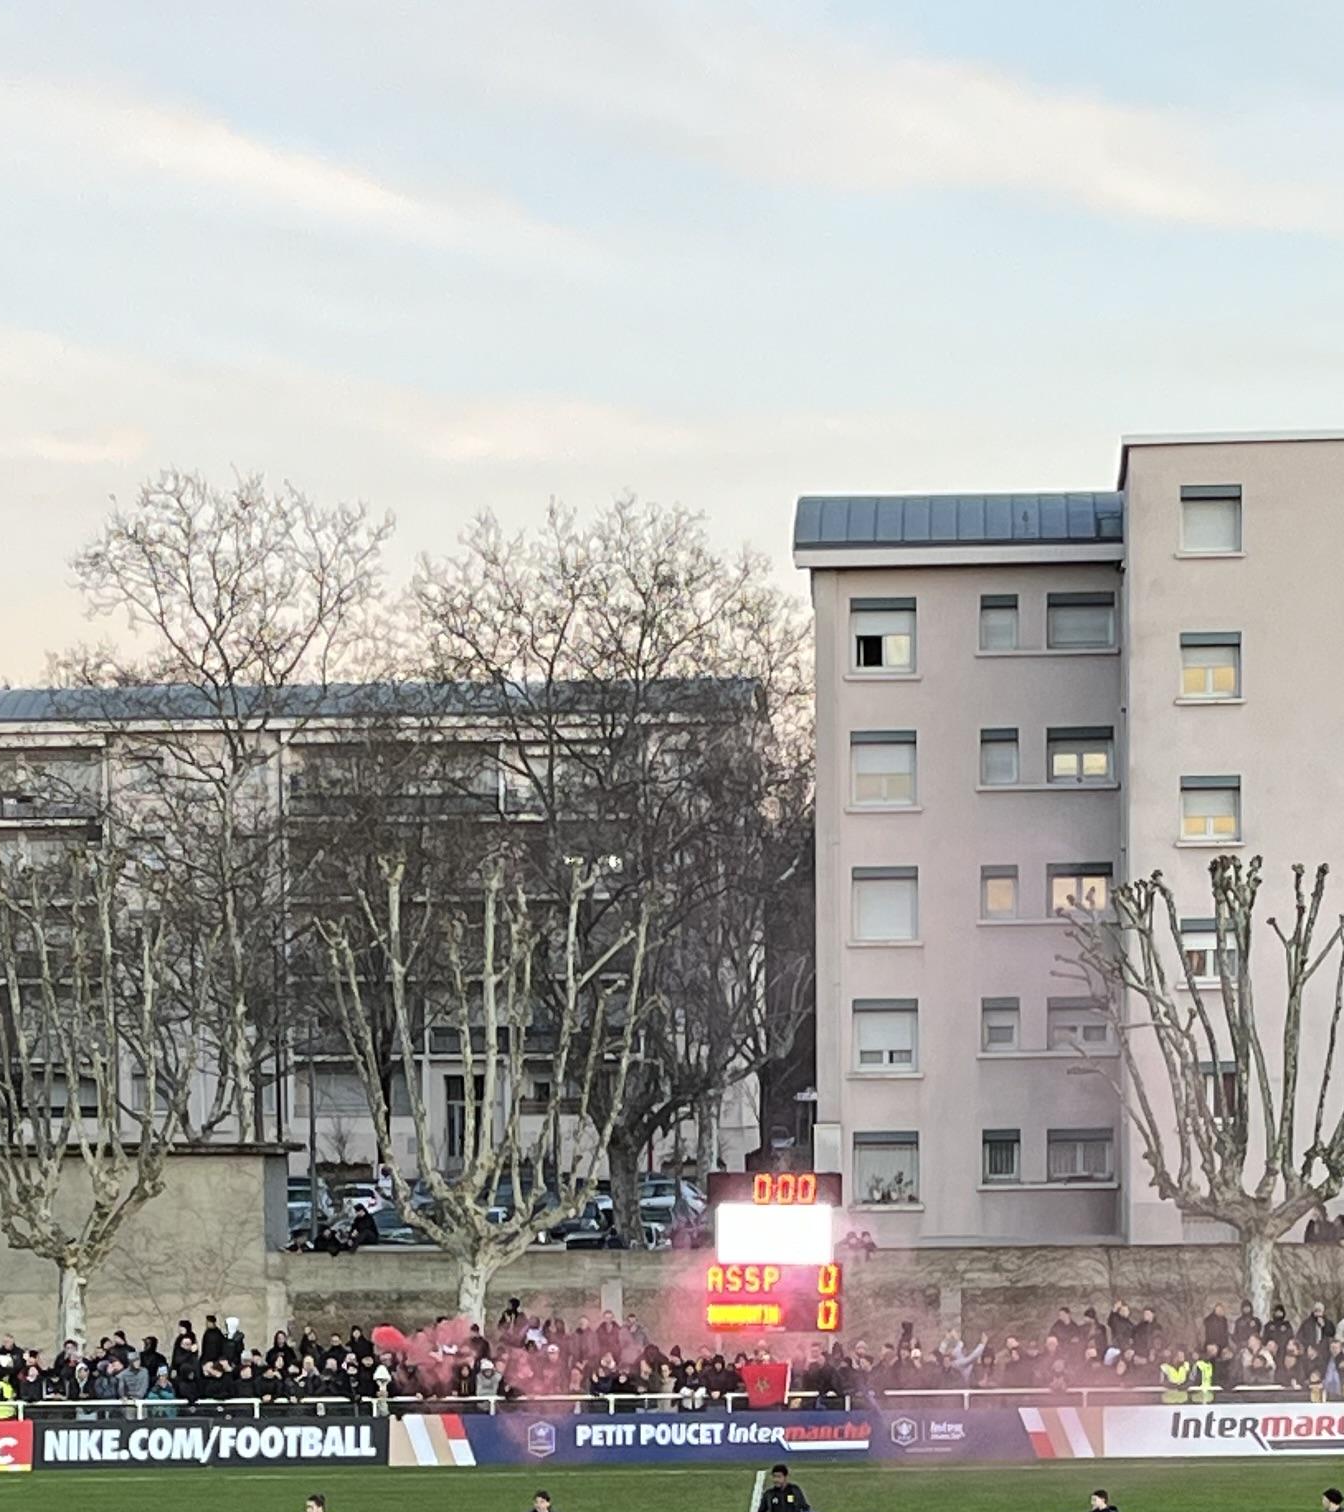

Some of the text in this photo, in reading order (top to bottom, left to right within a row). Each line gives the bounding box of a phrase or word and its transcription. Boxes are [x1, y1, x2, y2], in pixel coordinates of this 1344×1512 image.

[706, 1264, 840, 1295] ASSP 0
[816, 1299, 840, 1330] 0
[44, 1426, 376, 1463] NIKE.COM/FOOTBALL
[576, 1424, 636, 1447] PETIT
[640, 1422, 724, 1446] POUCET
